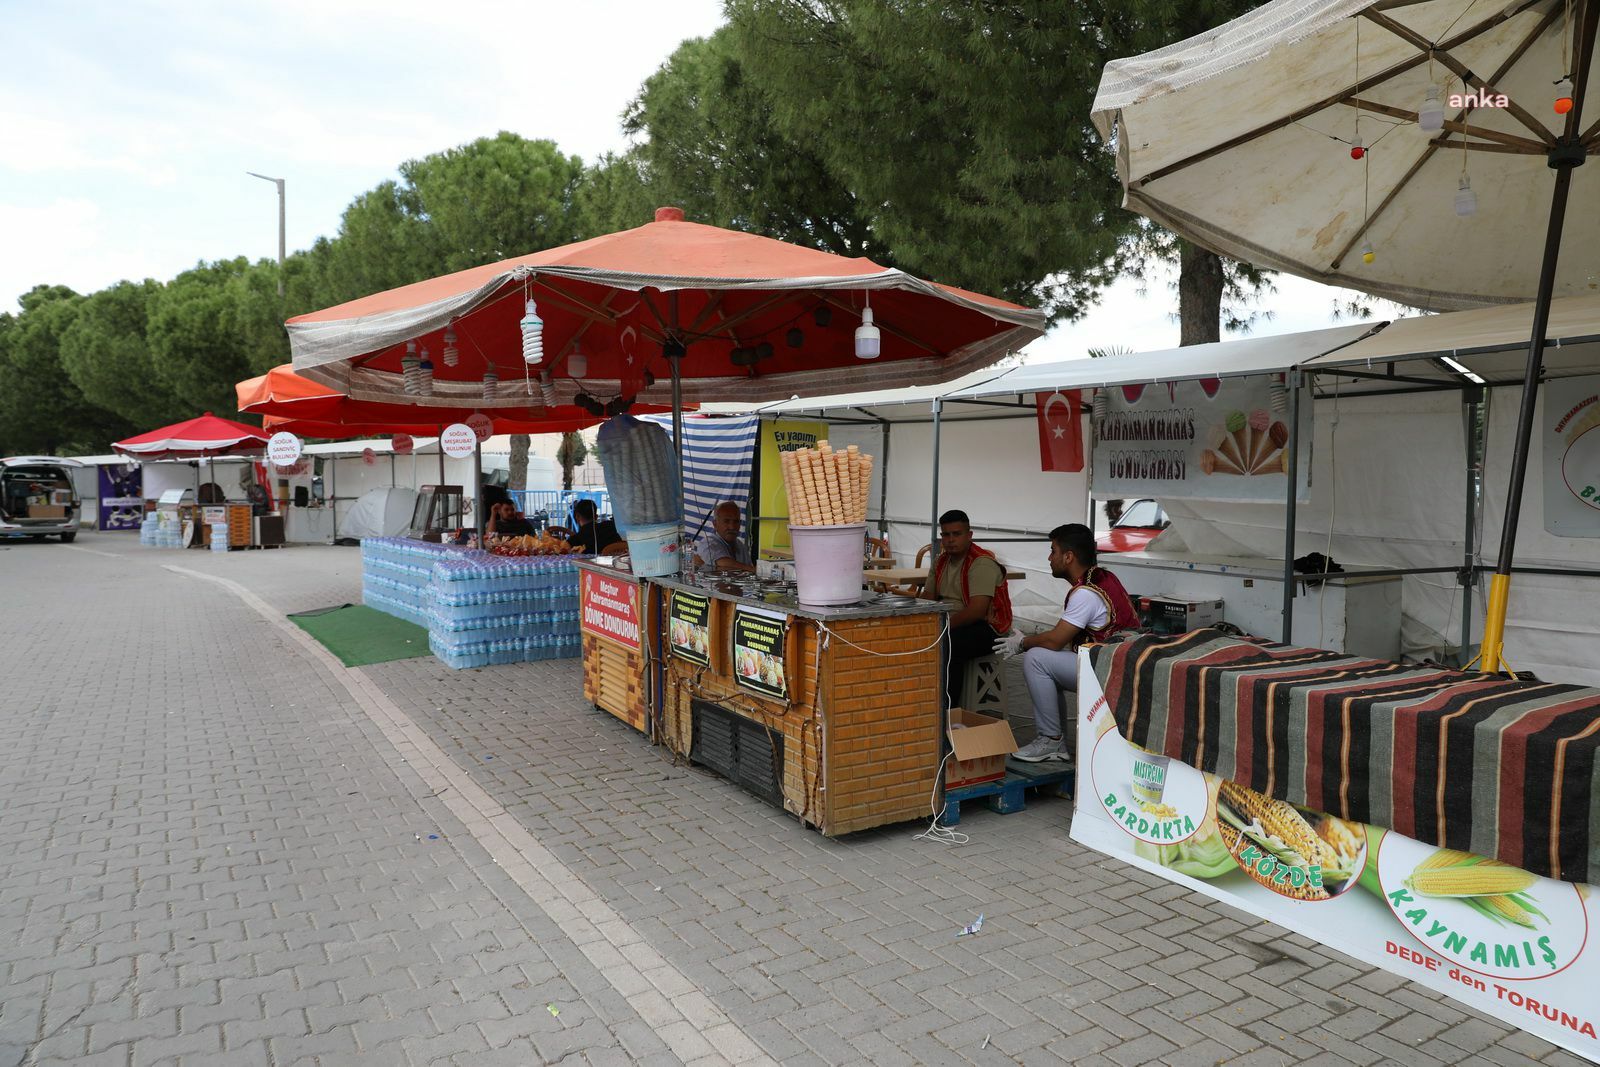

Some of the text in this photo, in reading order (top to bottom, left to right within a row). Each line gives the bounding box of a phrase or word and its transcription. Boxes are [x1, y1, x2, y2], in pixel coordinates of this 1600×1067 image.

[774, 431, 785, 442] Ev
[1100, 408, 1195, 445] KAHRAMANMARAŞ
[1110, 449, 1186, 480] DONDURMASI
[590, 591, 630, 617] Kahramanmaraş
[600, 580, 618, 598] Meşhur
[585, 603, 640, 643] DÖVME DONDURMA
[1104, 792, 1196, 840] BARDAKTA
[1240, 845, 1323, 888] KÖZDE
[1388, 888, 1557, 970] KAYNAMIŞ
[1385, 940, 1598, 1039] DEDE' den TORUNA
